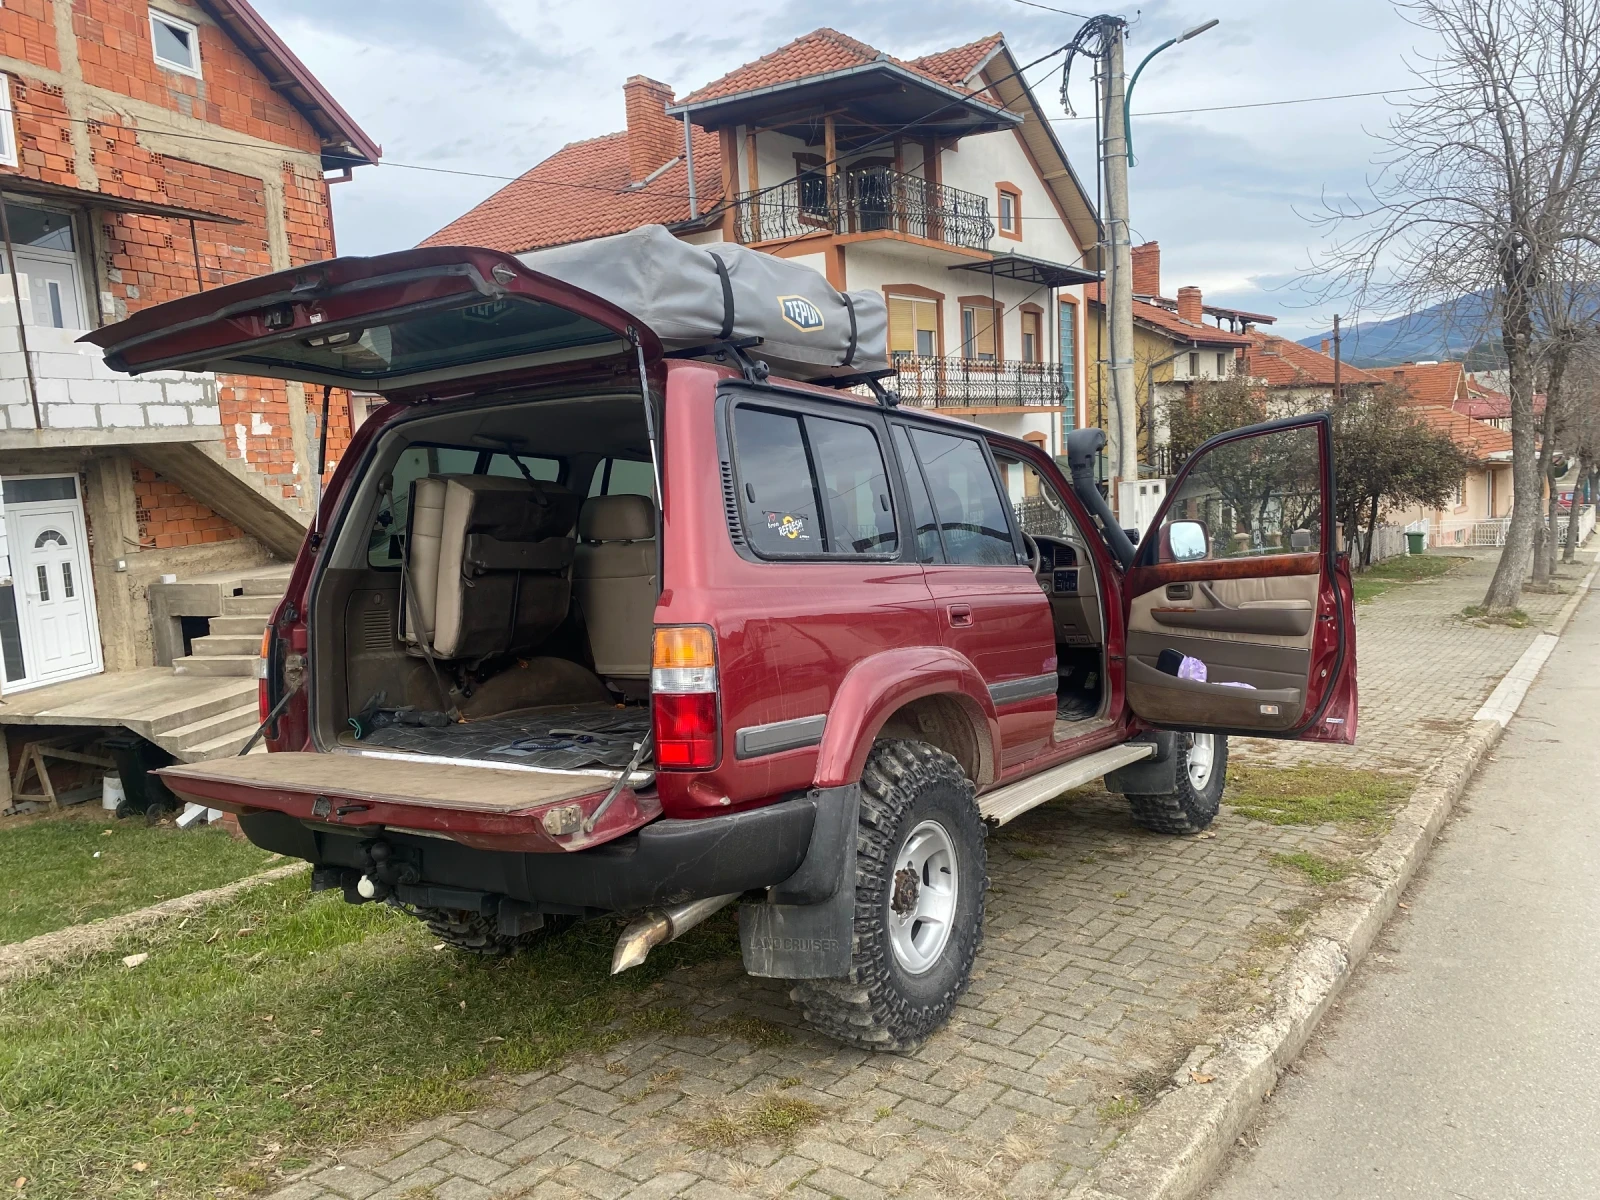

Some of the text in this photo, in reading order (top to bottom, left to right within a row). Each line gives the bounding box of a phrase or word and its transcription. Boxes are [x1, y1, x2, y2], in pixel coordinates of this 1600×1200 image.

[785, 300, 819, 325] TEPUI
[778, 519, 803, 537] REFRESH
[749, 936, 840, 952] LAND CRUISER
